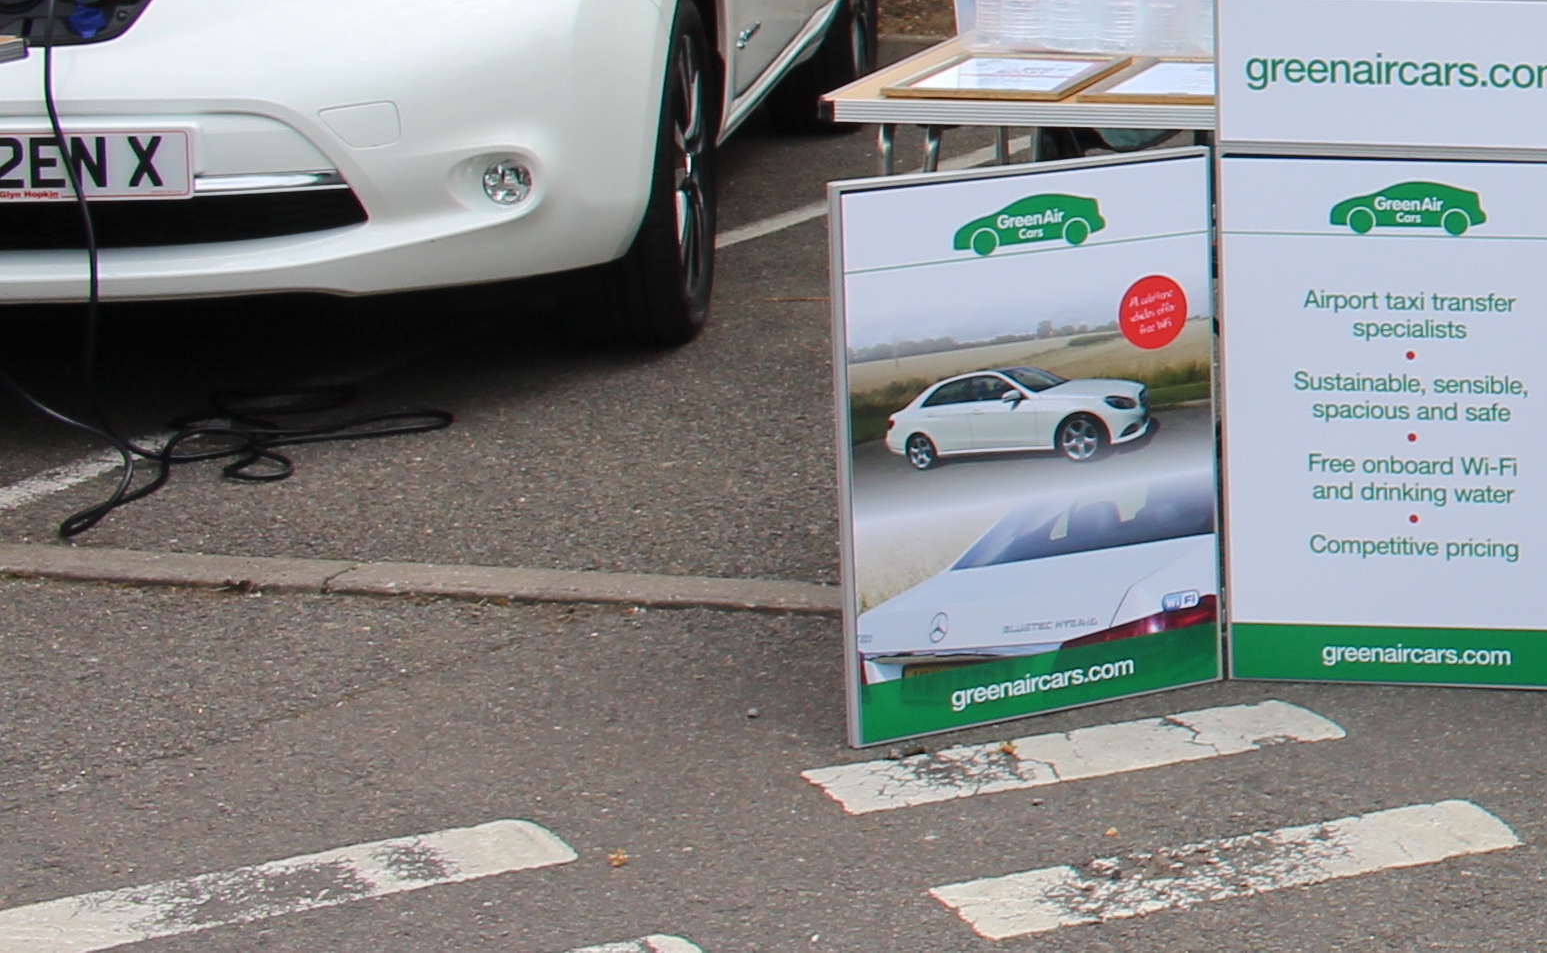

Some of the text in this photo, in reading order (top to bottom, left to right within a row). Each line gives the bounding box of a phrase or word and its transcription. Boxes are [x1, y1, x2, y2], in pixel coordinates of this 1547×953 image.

[127, 136, 163, 187] X
[1395, 212, 1422, 224] Cars
[1018, 227, 1044, 240] Cars
[1303, 289, 1517, 314] Airport taxi transfer
[1353, 319, 1467, 342] specialists
[1294, 371, 1528, 398] Sustainable, sensible,
[1312, 401, 1511, 423] spacious and safe
[1308, 453, 1518, 477] Free onboard Wi-Fi
[1312, 481, 1515, 507] and drinking water
[1310, 534, 1519, 562] Competitive pricing
[1322, 644, 1511, 666] greenaircars.com
[951, 658, 1135, 712] greenaircars.com
